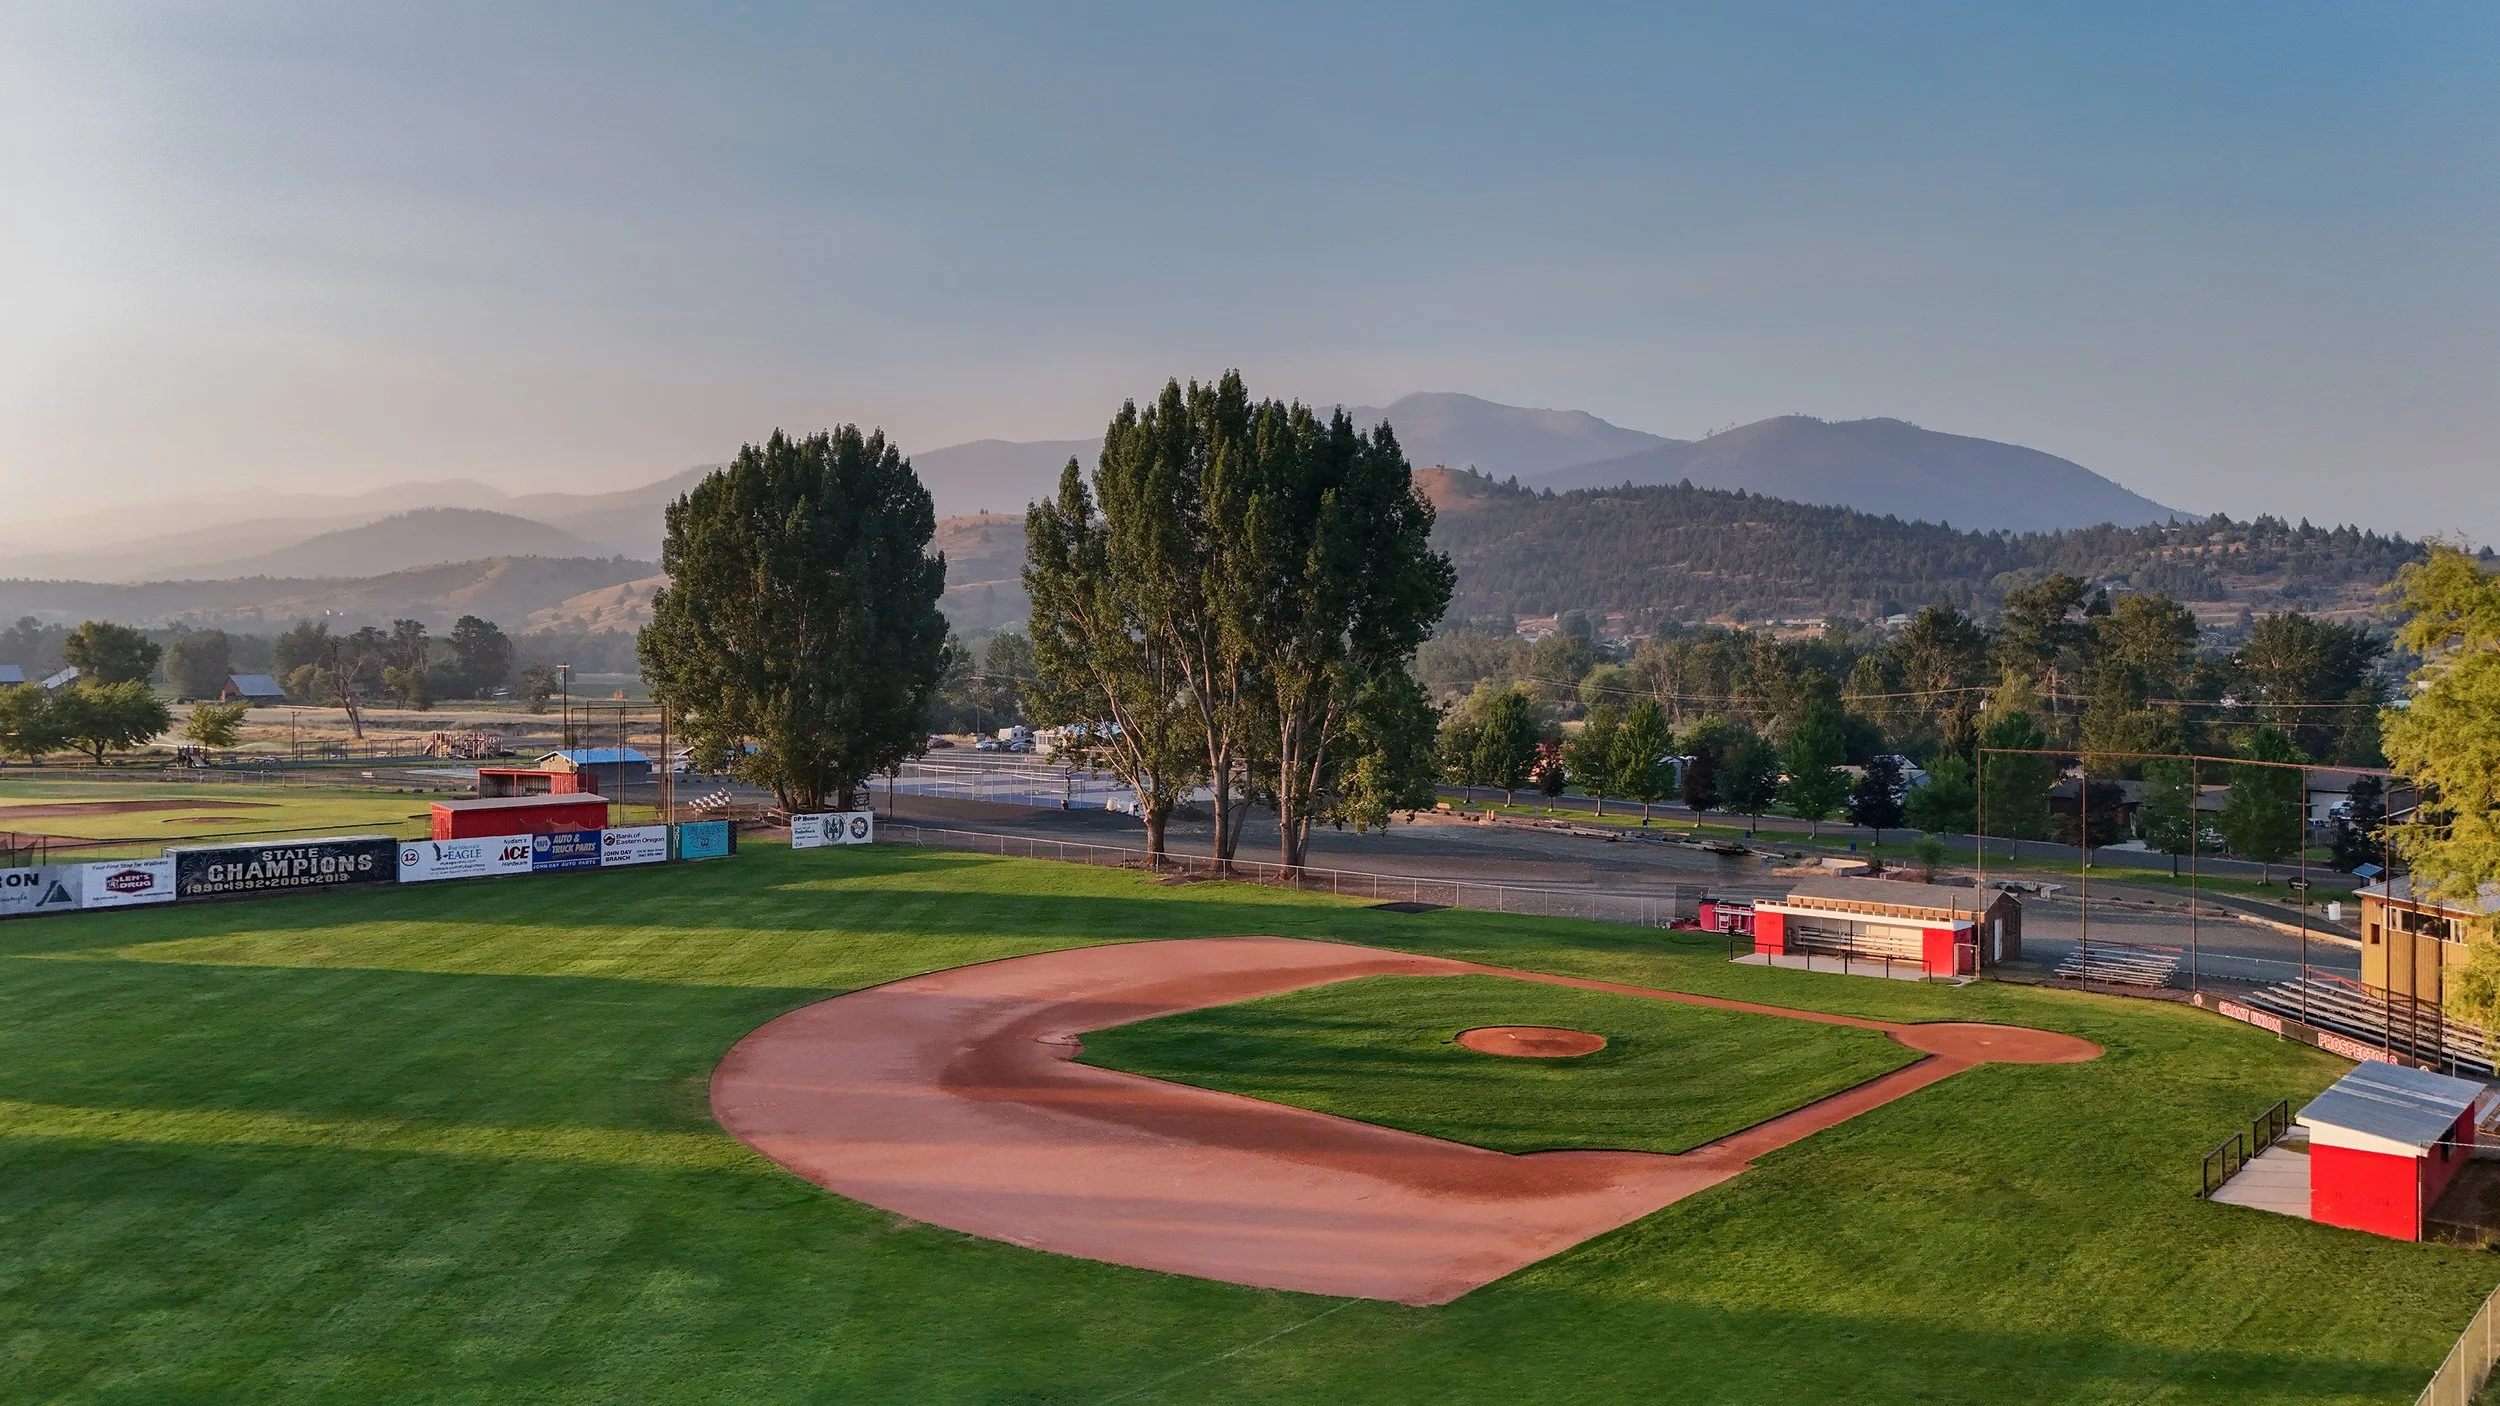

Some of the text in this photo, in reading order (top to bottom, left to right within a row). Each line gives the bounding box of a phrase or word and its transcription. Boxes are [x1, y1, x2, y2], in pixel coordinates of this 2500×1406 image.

[553, 833, 580, 844] AUTO &
[262, 847, 319, 861] STATE
[498, 846, 531, 861] ACE
[552, 842, 596, 854] TRUCK PARTS
[403, 853, 416, 861] 12
[447, 849, 482, 860] EAGLE
[208, 854, 373, 882] CHAMPIONS
[0, 873, 39, 888] ON
[119, 874, 150, 882] LEN'S
[119, 880, 151, 888] DRUG
[2219, 1001, 2282, 1033] GRANT UNION
